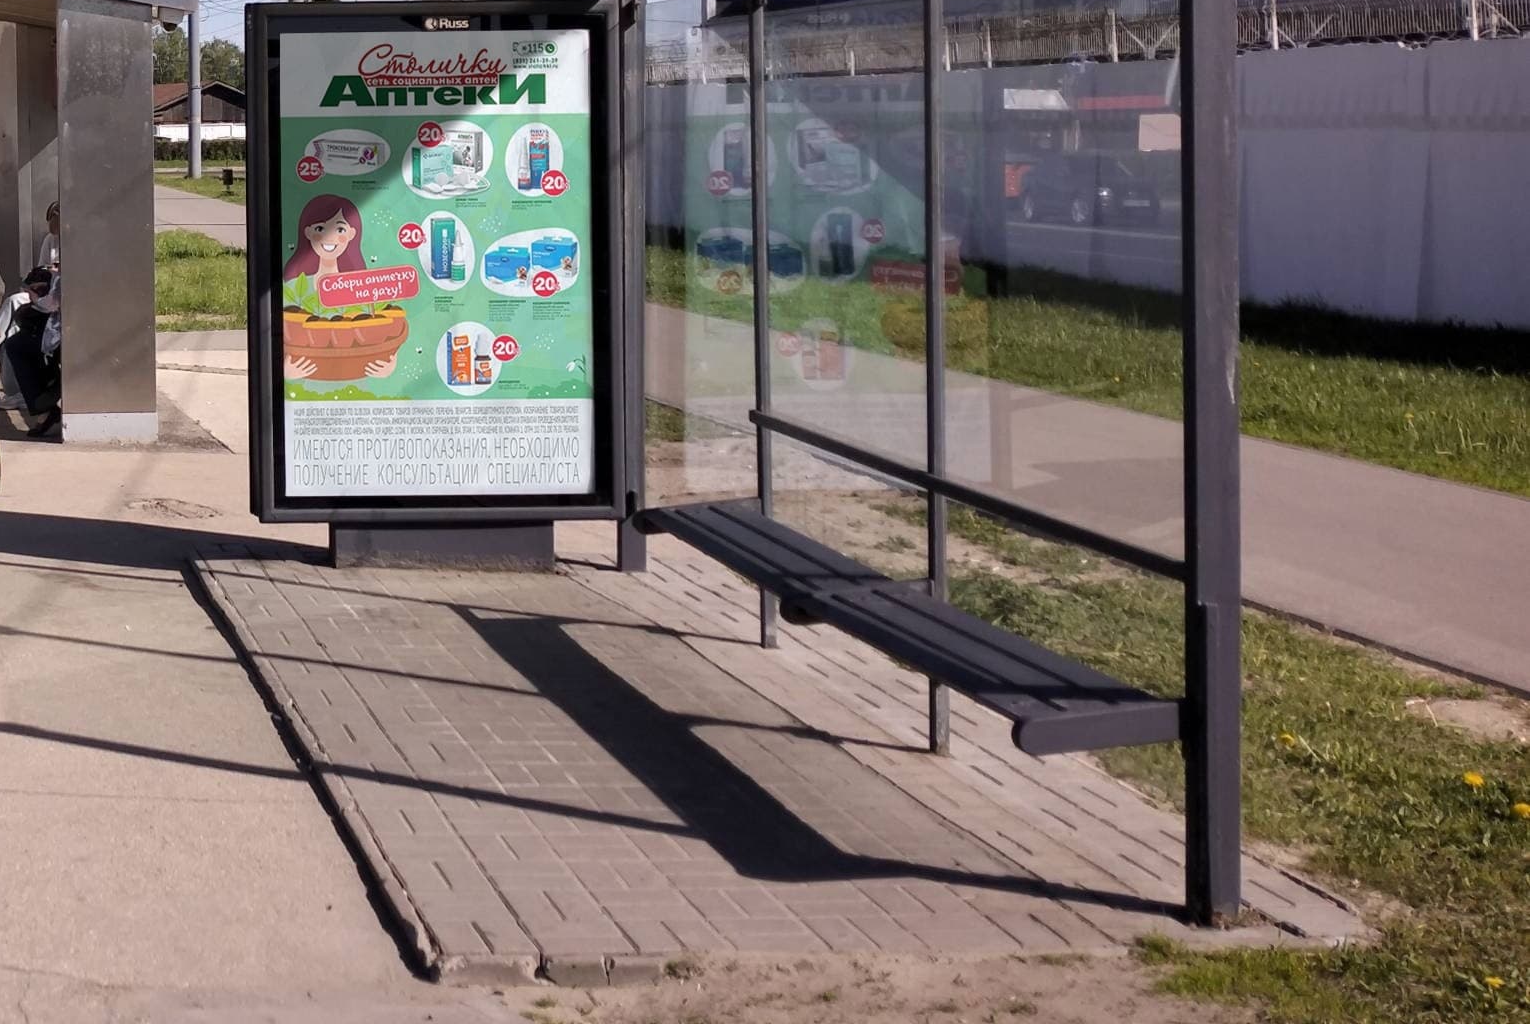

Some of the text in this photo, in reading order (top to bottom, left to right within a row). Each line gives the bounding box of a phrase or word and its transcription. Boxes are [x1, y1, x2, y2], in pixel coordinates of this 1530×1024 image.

[439, 18, 469, 29] Russ
[358, 43, 508, 77] Столички
[366, 76, 498, 86] сеть социальных аптек
[322, 270, 415, 292] Собери аптечку
[356, 281, 403, 301] на дачу!
[293, 436, 580, 461] ИМЕЮТСЯ ПРОТИВОПОКАЗАНИЯ. НЕОБХОДИМО
[294, 462, 580, 487] ПОЛУЧЕНИЕ КОНСУЛЬТАЦИИ СПЕЦИАЛИСТА
